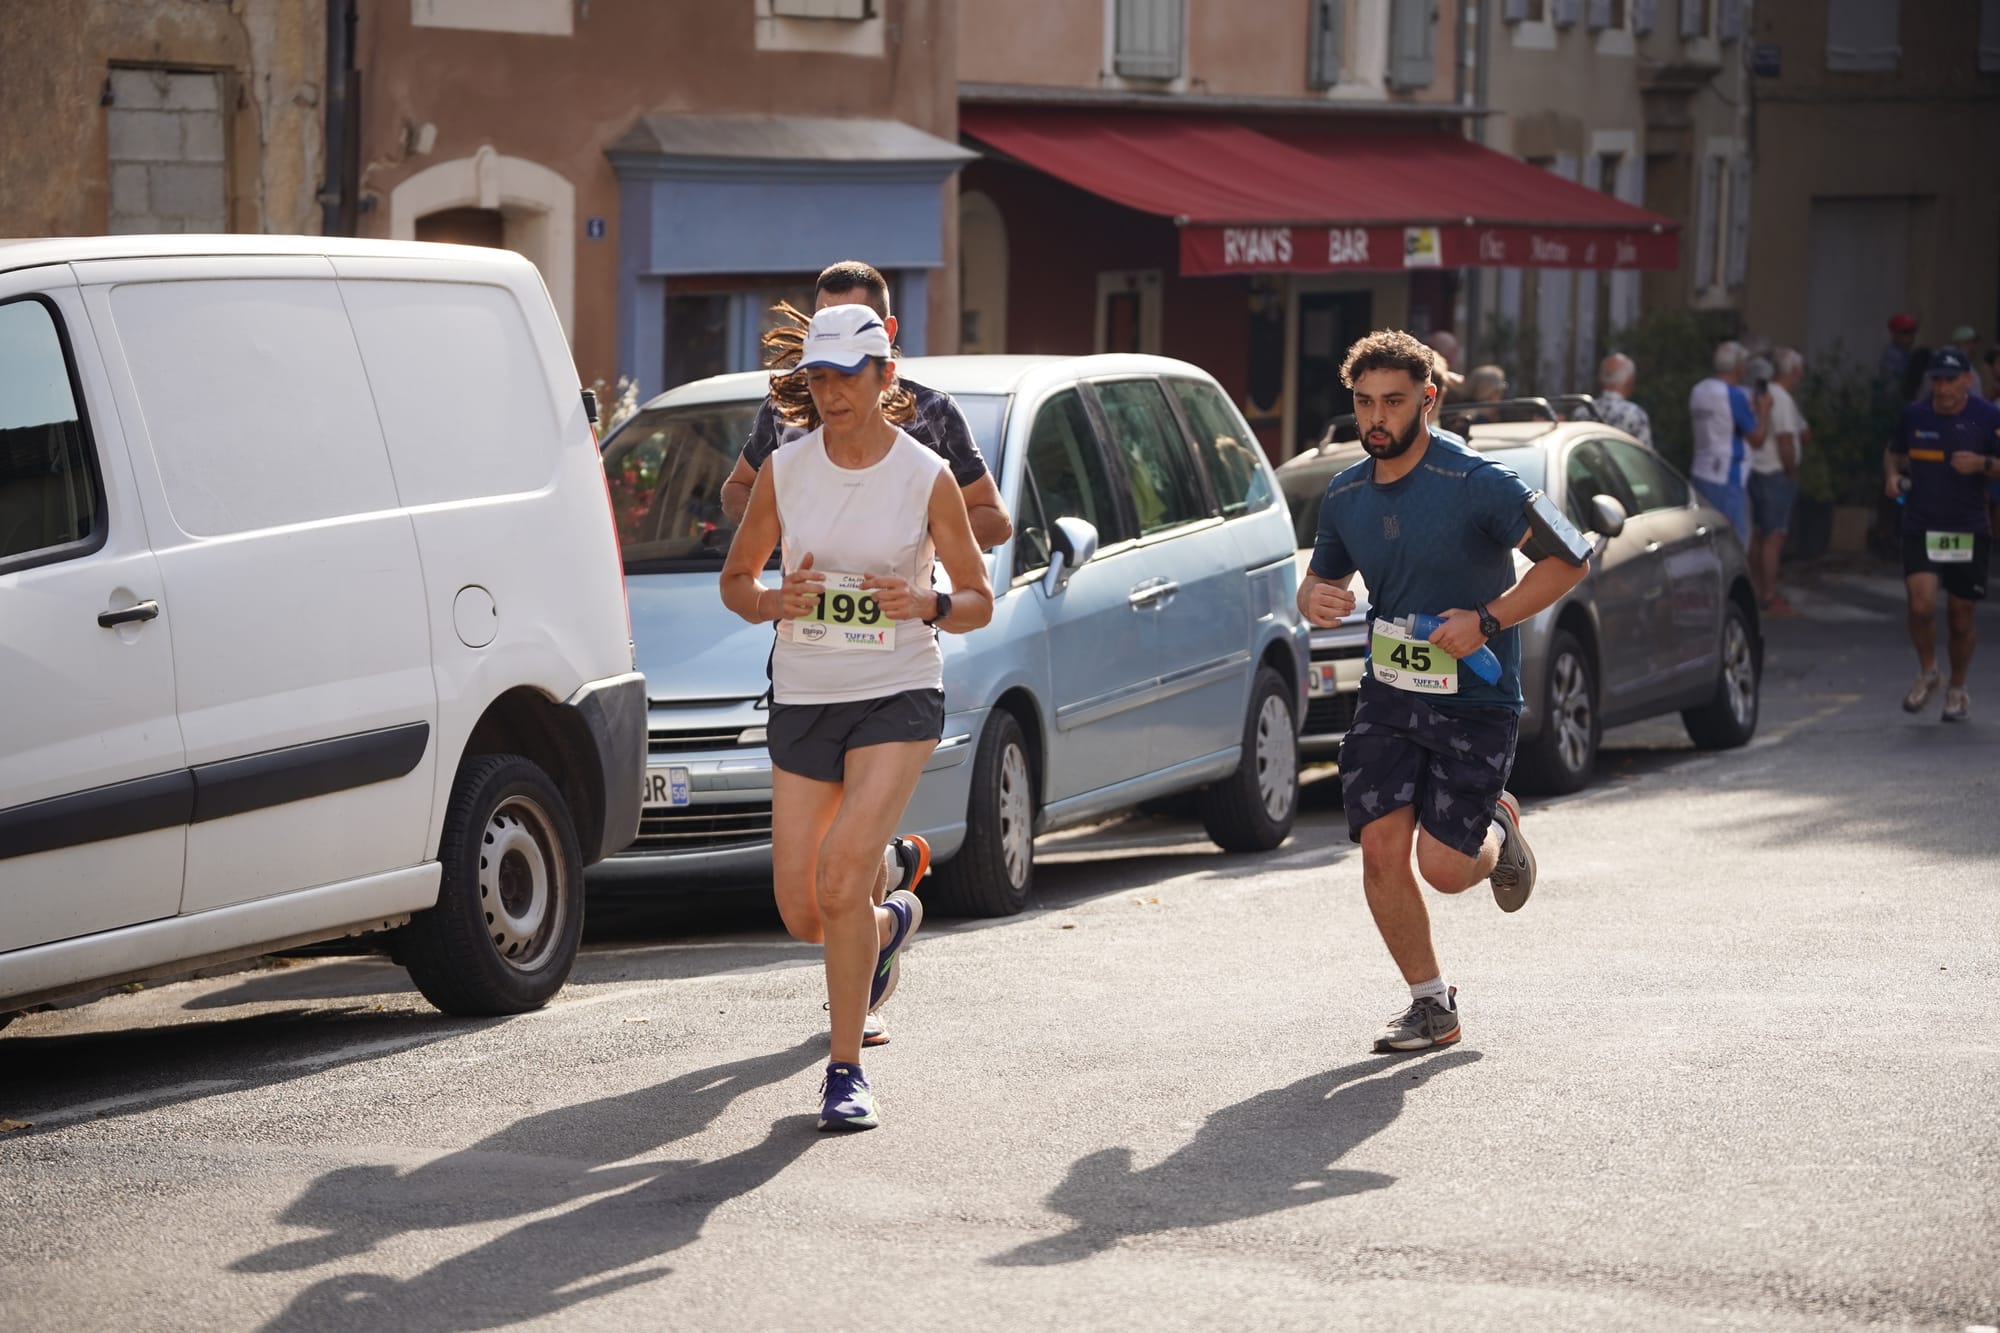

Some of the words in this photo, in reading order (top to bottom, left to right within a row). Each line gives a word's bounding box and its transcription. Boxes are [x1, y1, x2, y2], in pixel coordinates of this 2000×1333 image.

[1224, 227, 1293, 265] RYAN'S
[1328, 228, 1369, 263] BAR
[816, 592, 881, 624] 199
[844, 632, 875, 641] TUFF'S
[1390, 644, 1431, 672] 45
